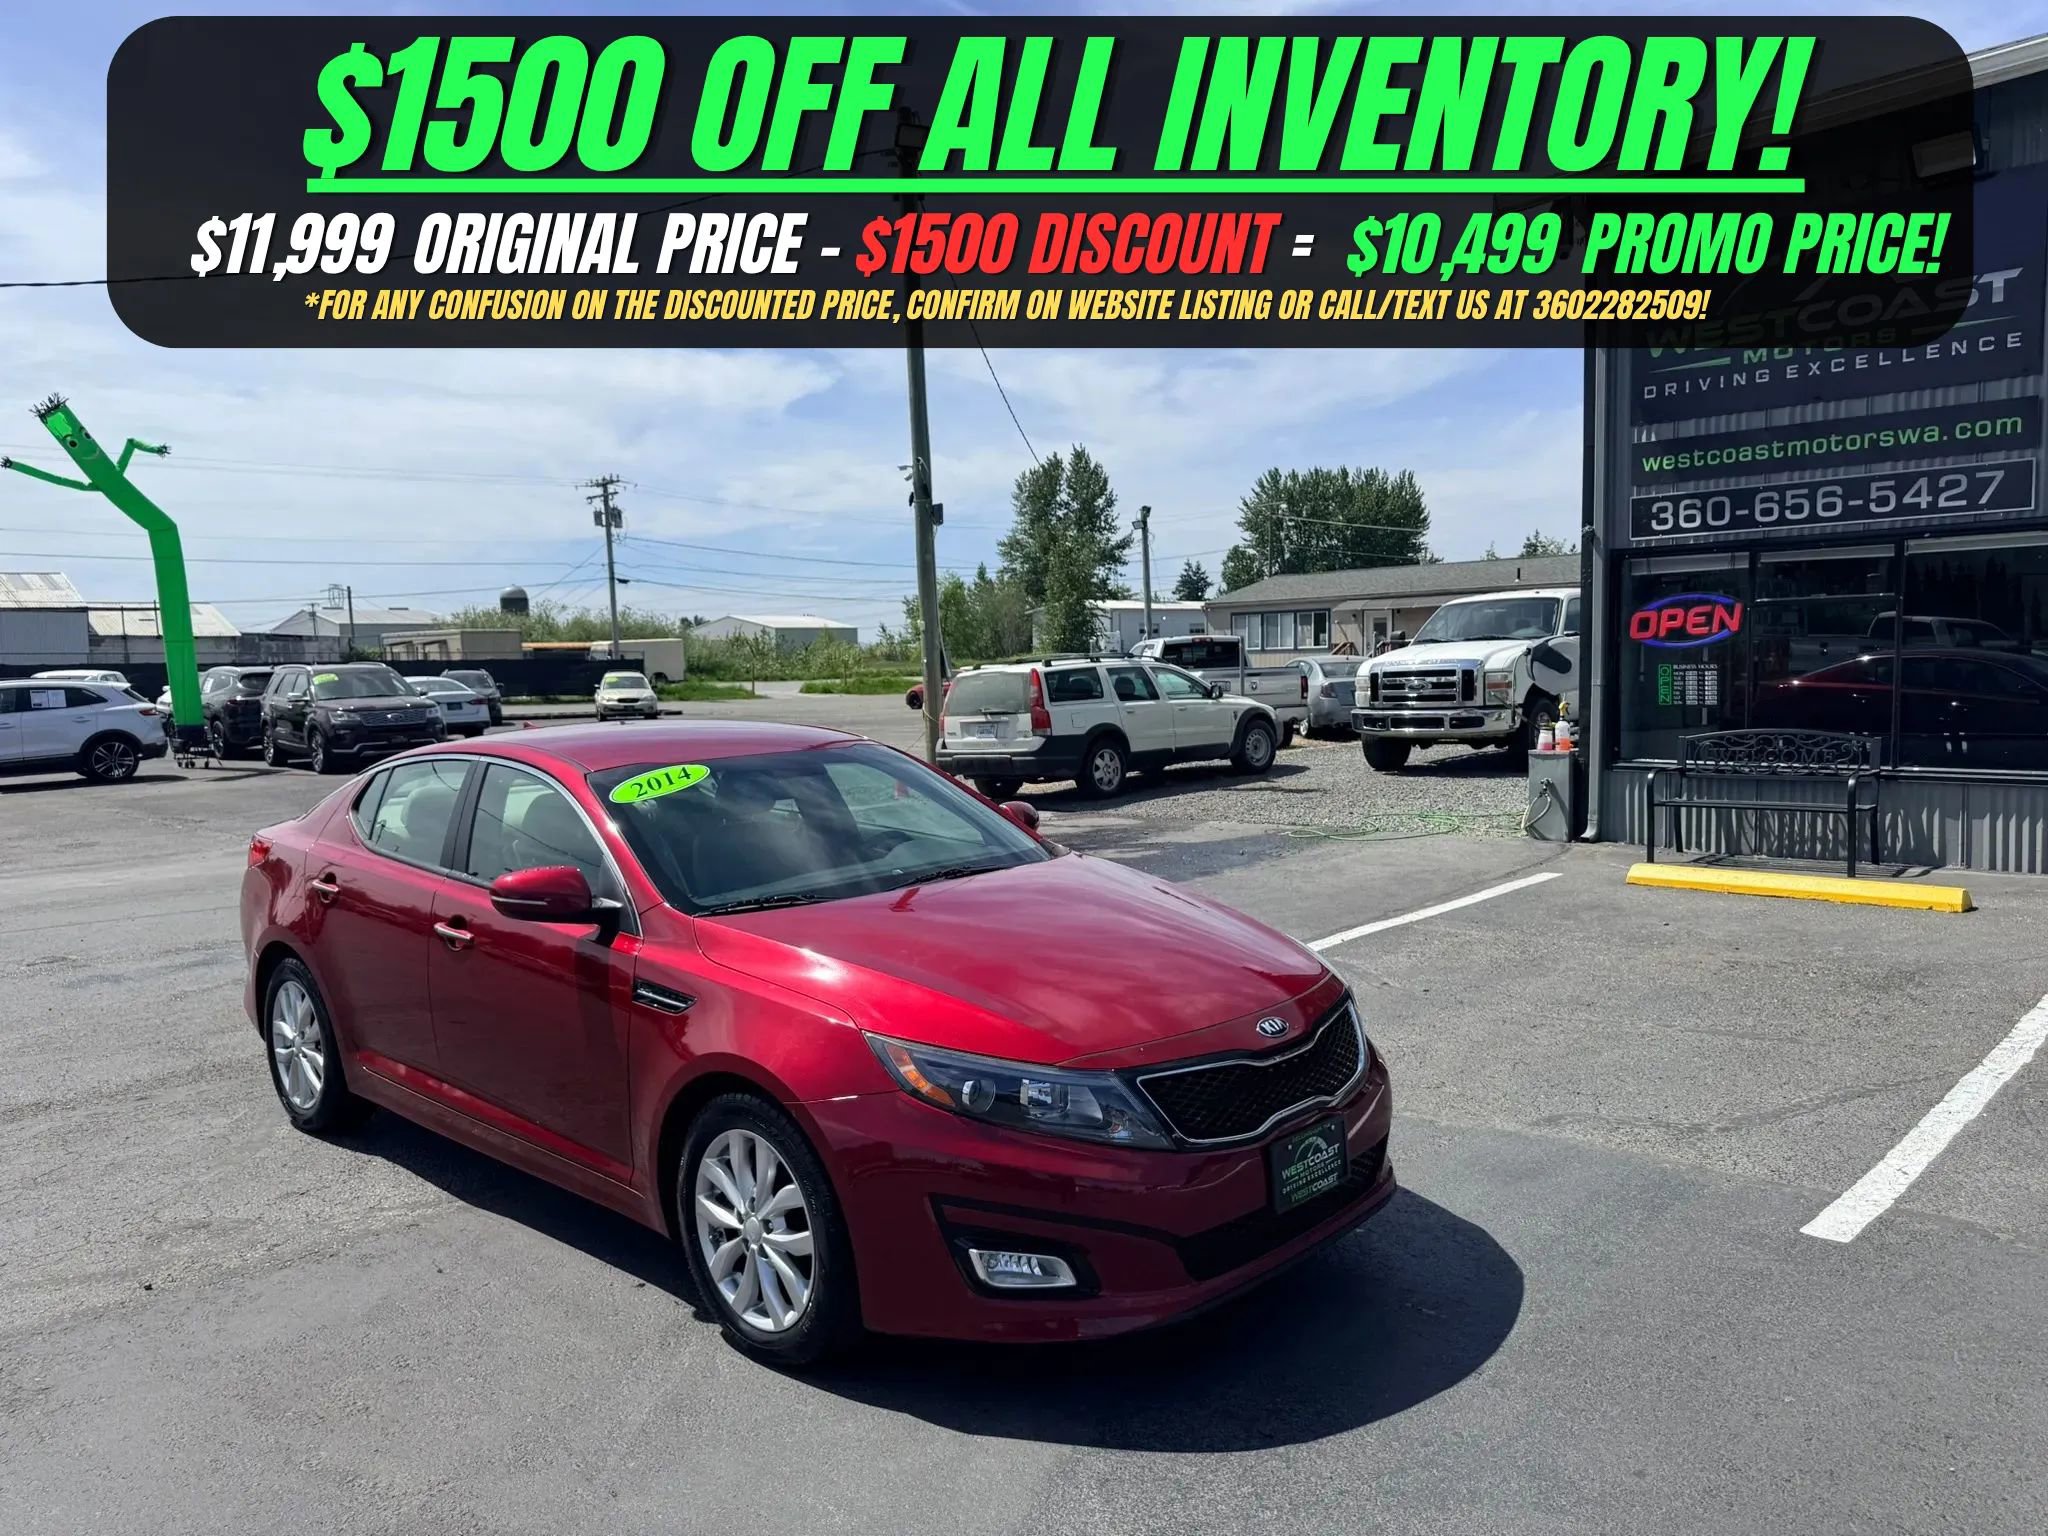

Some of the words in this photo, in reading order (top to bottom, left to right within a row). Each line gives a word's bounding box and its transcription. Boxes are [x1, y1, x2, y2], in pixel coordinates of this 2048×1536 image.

[1645, 267, 2024, 358] WESTCOAST
[1644, 369, 1770, 399] DRIVING
[1786, 331, 2023, 379] EXCELLENCE
[1743, 328, 1897, 365] MOTORS
[1642, 416, 2023, 472] westcoastmotorswa.com
[1651, 470, 2006, 530] 360-656-5427
[1630, 602, 1744, 640] OPEN
[631, 767, 692, 798] 2014
[1260, 1018, 1287, 1034] KIA
[1282, 1143, 1340, 1180] WESTCOAST
[1291, 1172, 1339, 1202] WESTCOAST
